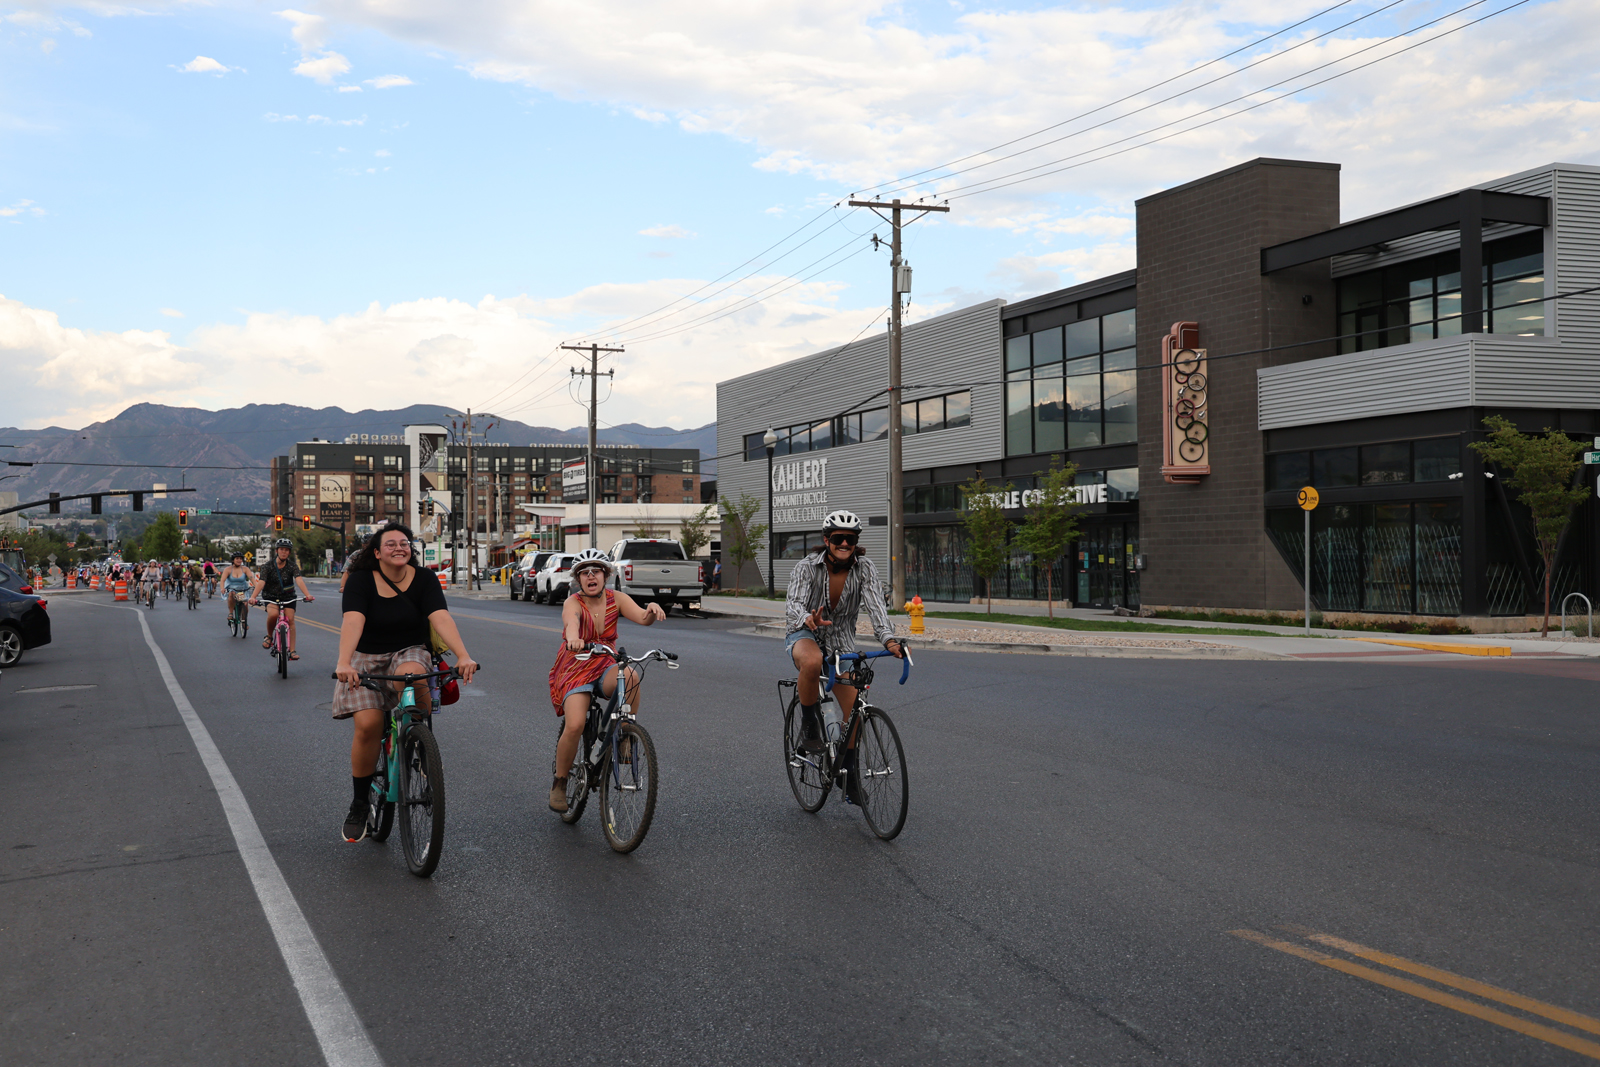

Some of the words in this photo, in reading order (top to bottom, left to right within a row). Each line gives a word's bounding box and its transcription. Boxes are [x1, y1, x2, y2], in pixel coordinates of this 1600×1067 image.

[773, 494, 802, 507] OMMUNITY
[804, 491, 827, 504] BICYCLE
[1298, 490, 1307, 506] 9
[772, 508, 800, 523] ESOURCE
[802, 506, 828, 521] CENTER
